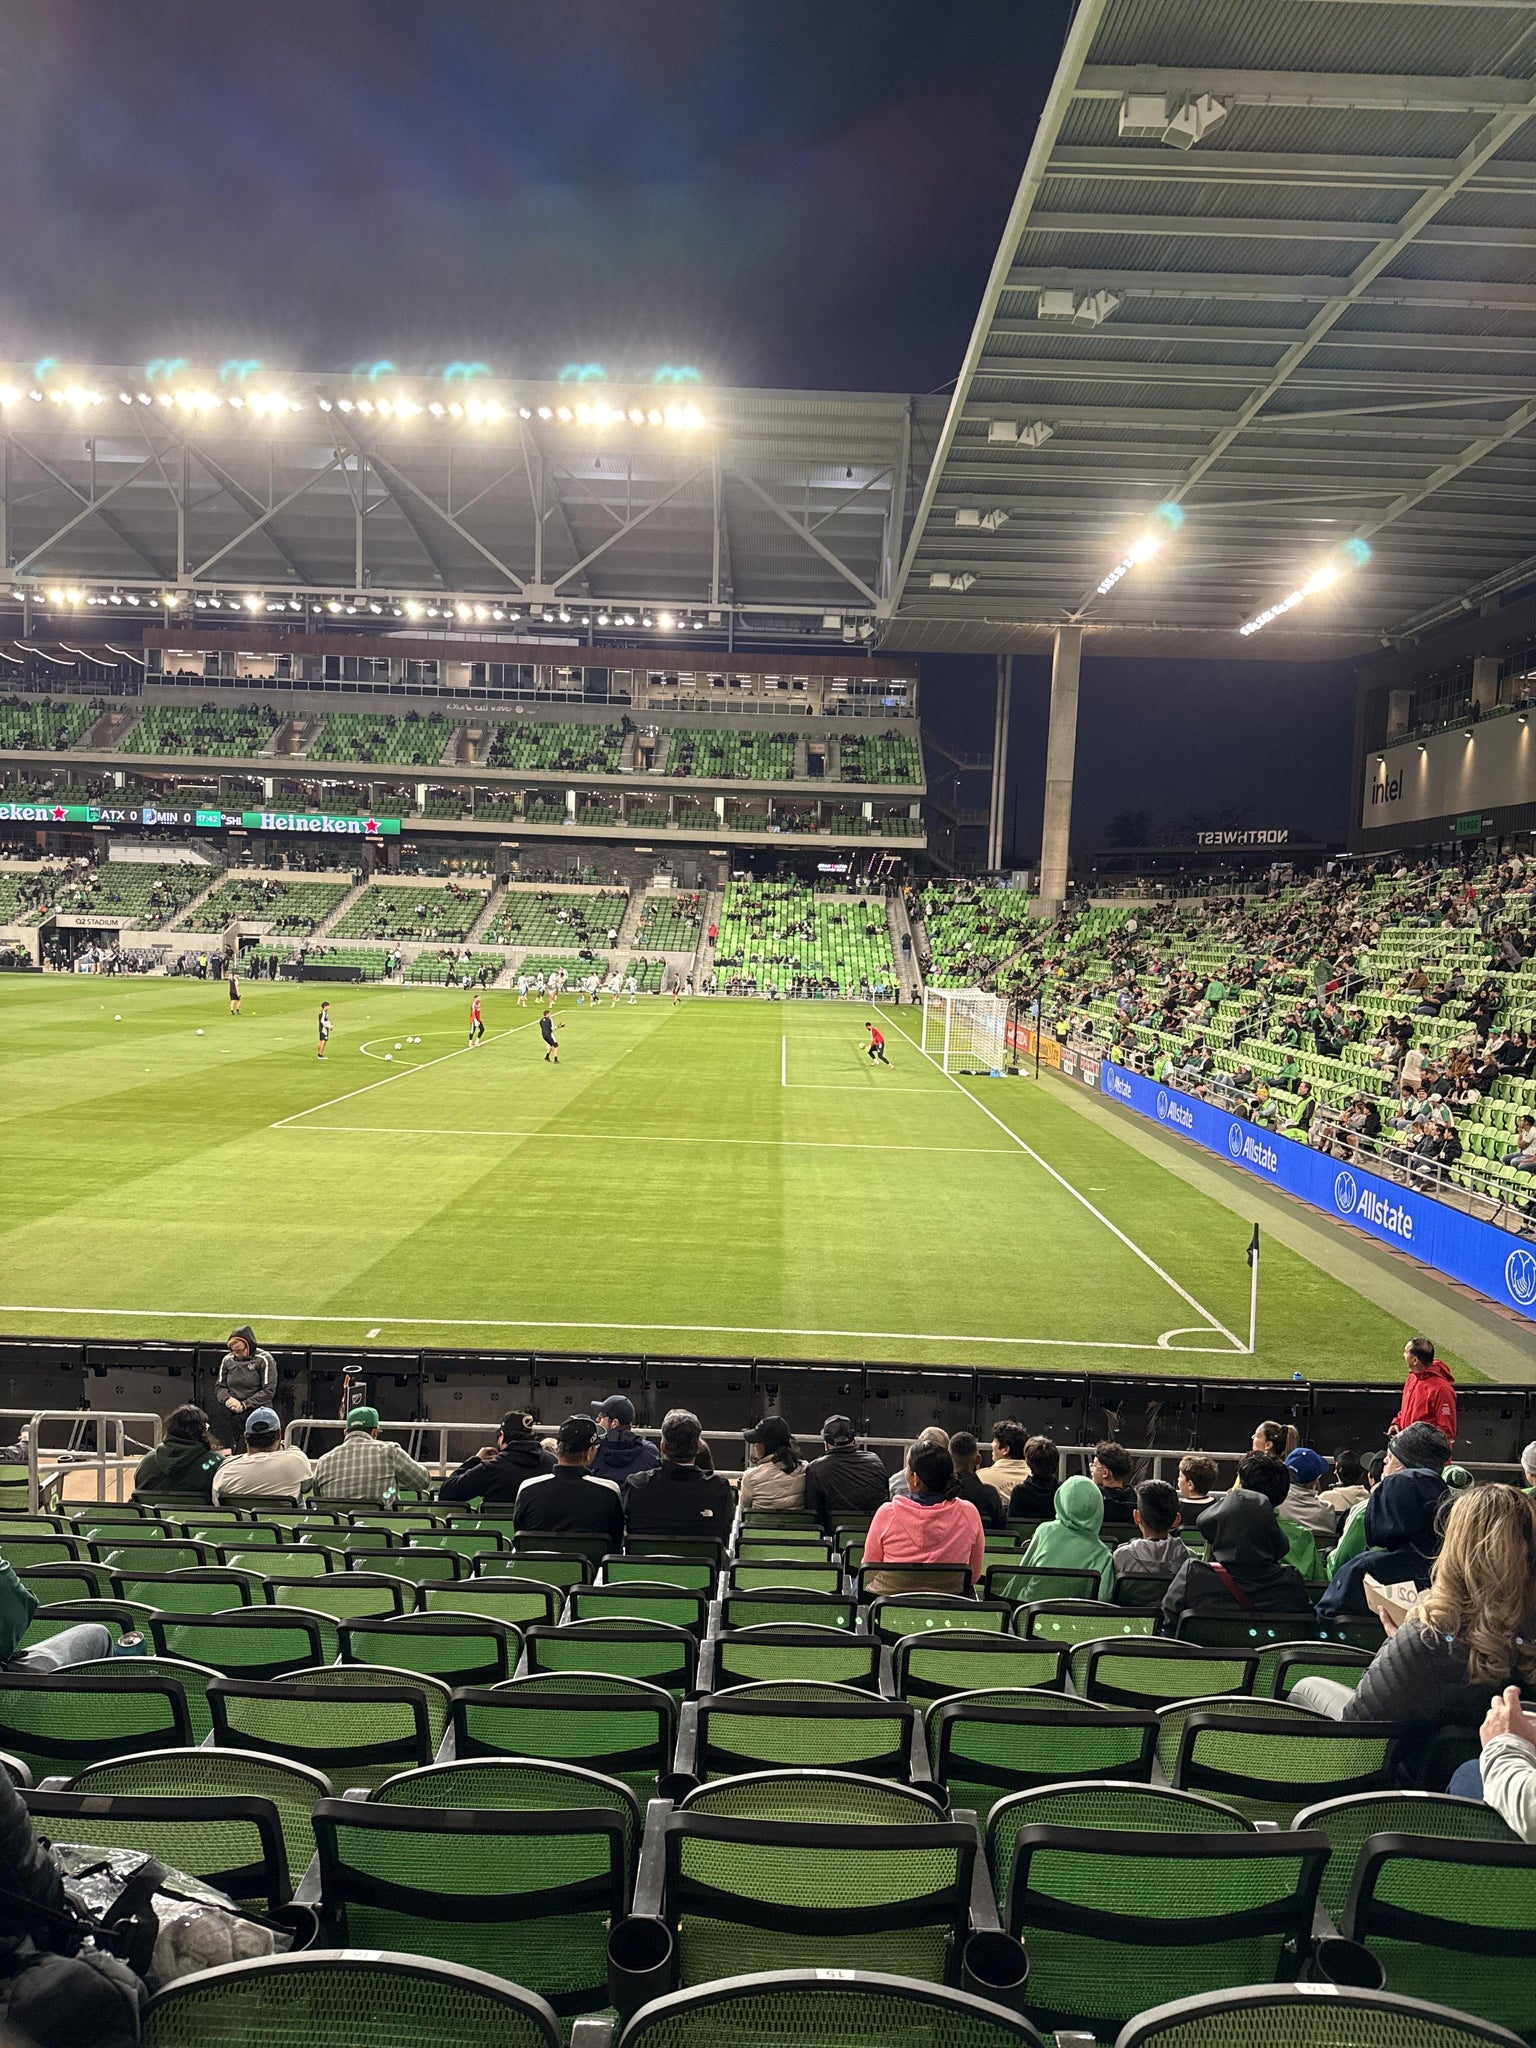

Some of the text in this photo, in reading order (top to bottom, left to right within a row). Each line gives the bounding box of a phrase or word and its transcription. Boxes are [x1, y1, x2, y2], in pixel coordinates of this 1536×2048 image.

[101, 810, 138, 821] ATX 0
[157, 812, 191, 823] MIN 0
[198, 814, 218, 823] 17:42
[260, 813, 361, 834] Heineken
[87, 918, 119, 926] STADIUM
[1113, 1075, 1132, 1099] Allstate
[1167, 1101, 1193, 1129] Allstate
[1242, 1136, 1278, 1173] Allstate
[1356, 1189, 1413, 1240] Allstate
[826, 1970, 845, 1978] 15
